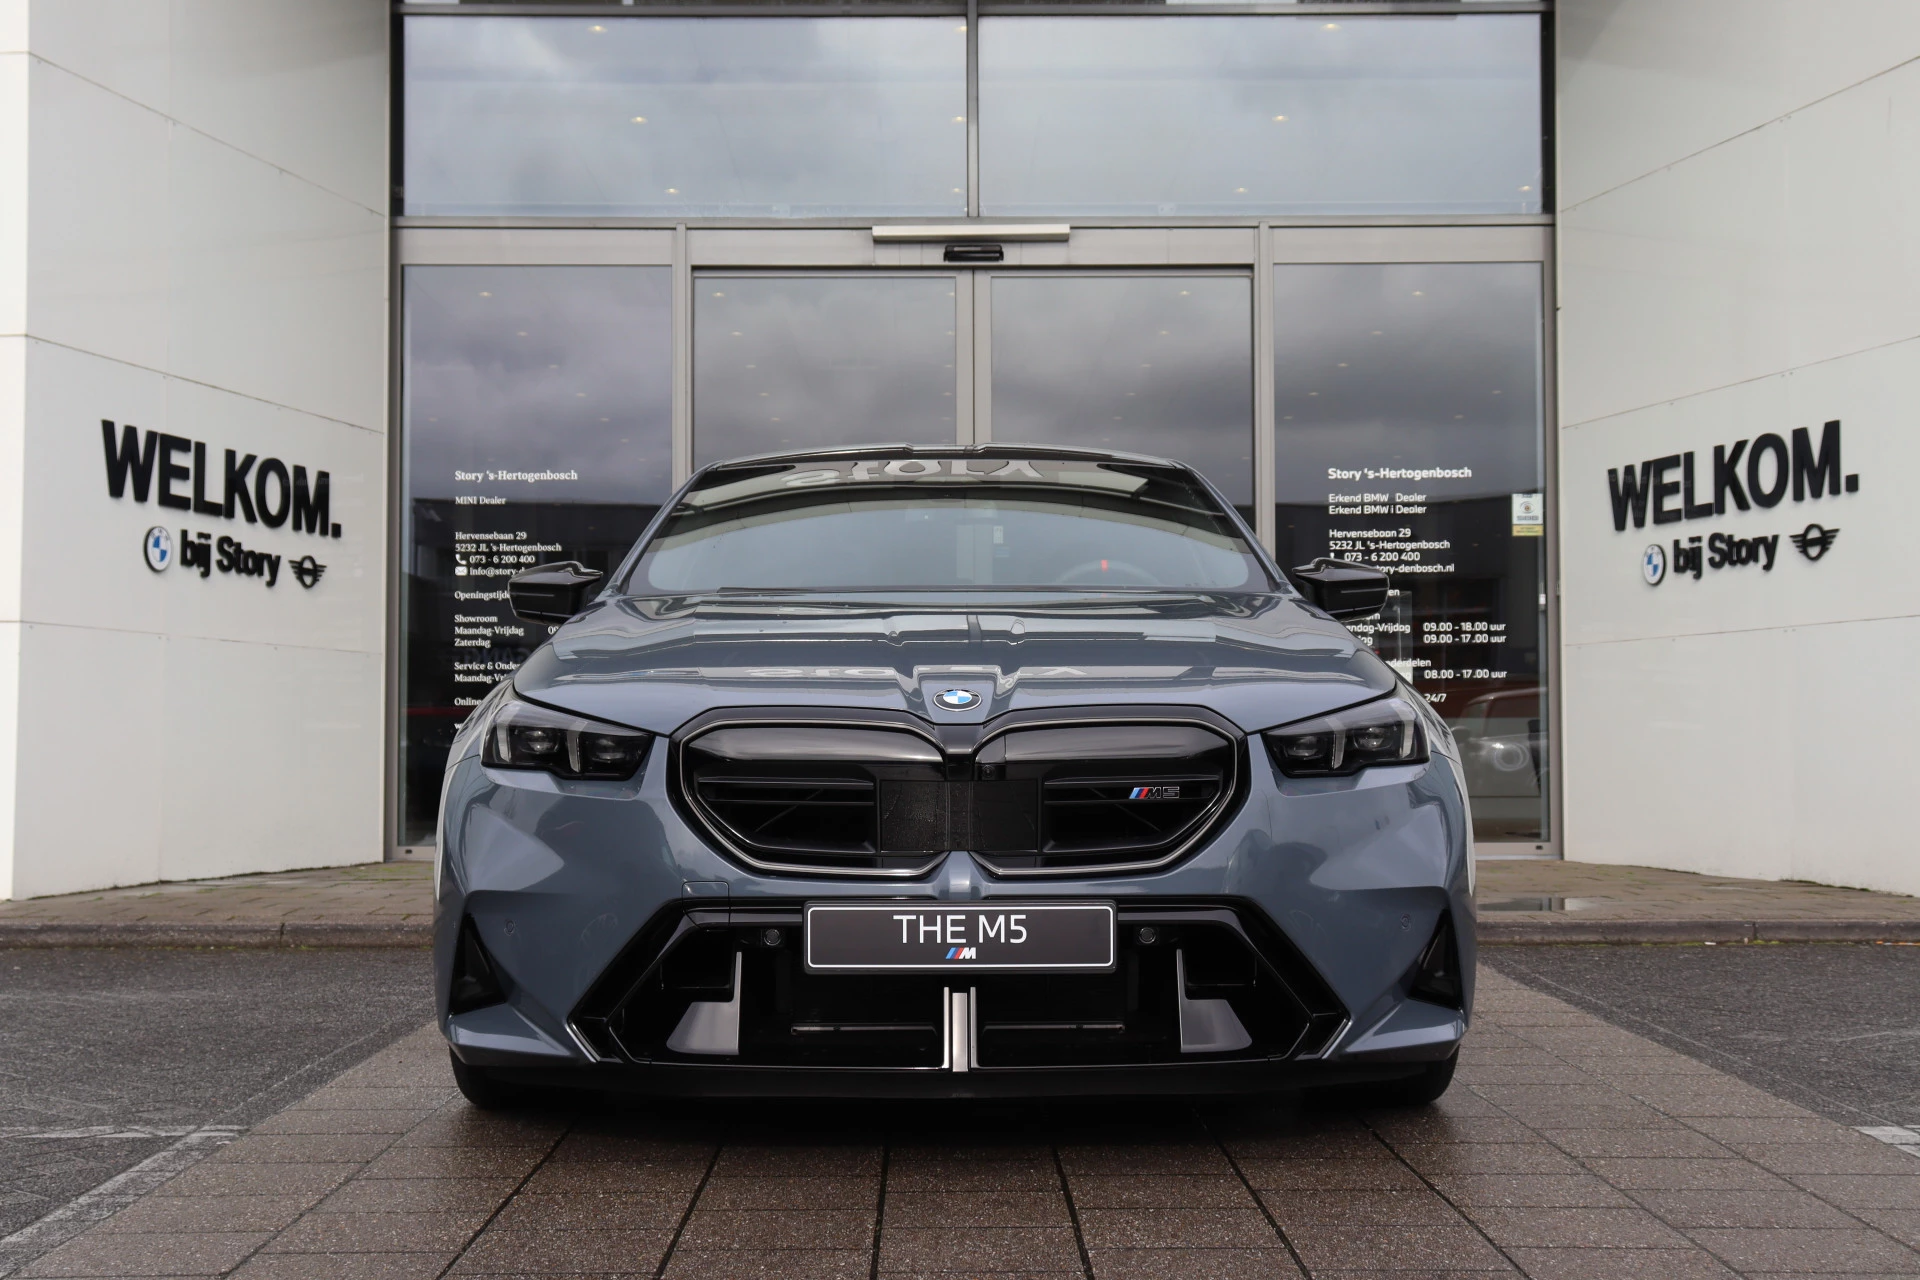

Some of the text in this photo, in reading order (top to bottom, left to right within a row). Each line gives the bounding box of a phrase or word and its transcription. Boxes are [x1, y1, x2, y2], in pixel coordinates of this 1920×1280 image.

[101, 419, 342, 538] WELKOM.
[455, 470, 484, 482] Story
[1328, 468, 1362, 481] Story
[1608, 420, 1859, 532] WELKOM.
[455, 496, 506, 505] MINI Dealer
[1328, 493, 1427, 502] Erkend BMW Dealer
[1328, 505, 1361, 514] Erkend
[1363, 505, 1389, 514] BMW
[1395, 505, 1427, 514] Dealer
[455, 531, 527, 540] Hervensebaan 29
[1329, 528, 1411, 538] Hervensebaan 29
[455, 543, 476, 552] 5232
[478, 543, 489, 552] JL
[1329, 541, 1353, 550] 5232
[1354, 541, 1365, 551] JL
[180, 529, 281, 587] bij Story
[469, 555, 486, 564] 073
[492, 555, 499, 564] 6
[500, 555, 517, 564] 200
[518, 555, 536, 564] 400
[1344, 552, 1362, 562] 073
[1371, 552, 1378, 561] 6
[1379, 552, 1399, 561] 200
[1400, 552, 1421, 561] 400
[1673, 532, 1779, 580] bij Story
[454, 614, 498, 623] Showroom
[454, 626, 524, 636] Maandag-Vrijdag
[1422, 622, 1453, 632] 09.00
[1461, 622, 1488, 632] 18.00
[1489, 623, 1506, 631] uur
[454, 638, 491, 648] Zaterdag
[1423, 634, 1453, 643] 09.00
[1490, 635, 1507, 643] uur
[454, 662, 486, 670] Service
[487, 662, 494, 670] &
[454, 673, 507, 684] Maandag-Vr
[1424, 669, 1454, 679] 08.00
[1491, 670, 1508, 678] uur
[1424, 693, 1447, 703] 24/7
[893, 914, 1027, 944] THE M5
